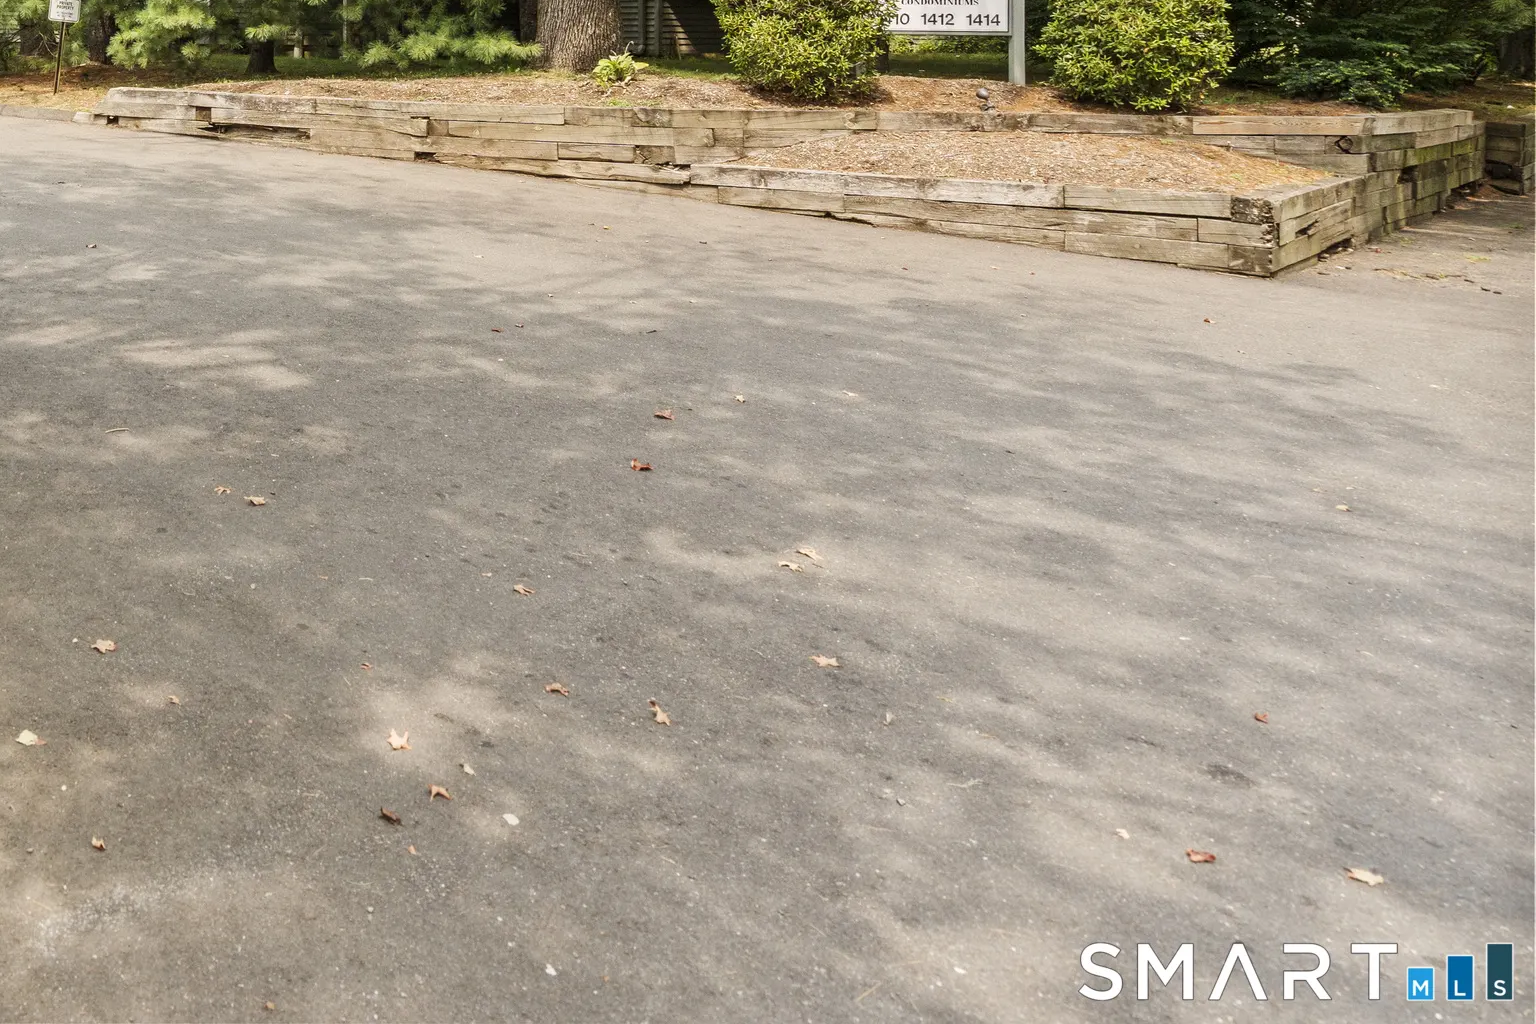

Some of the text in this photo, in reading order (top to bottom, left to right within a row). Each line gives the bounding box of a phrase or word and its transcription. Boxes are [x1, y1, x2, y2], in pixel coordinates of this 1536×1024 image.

[885, 13, 1001, 27] 10 1412 1414
